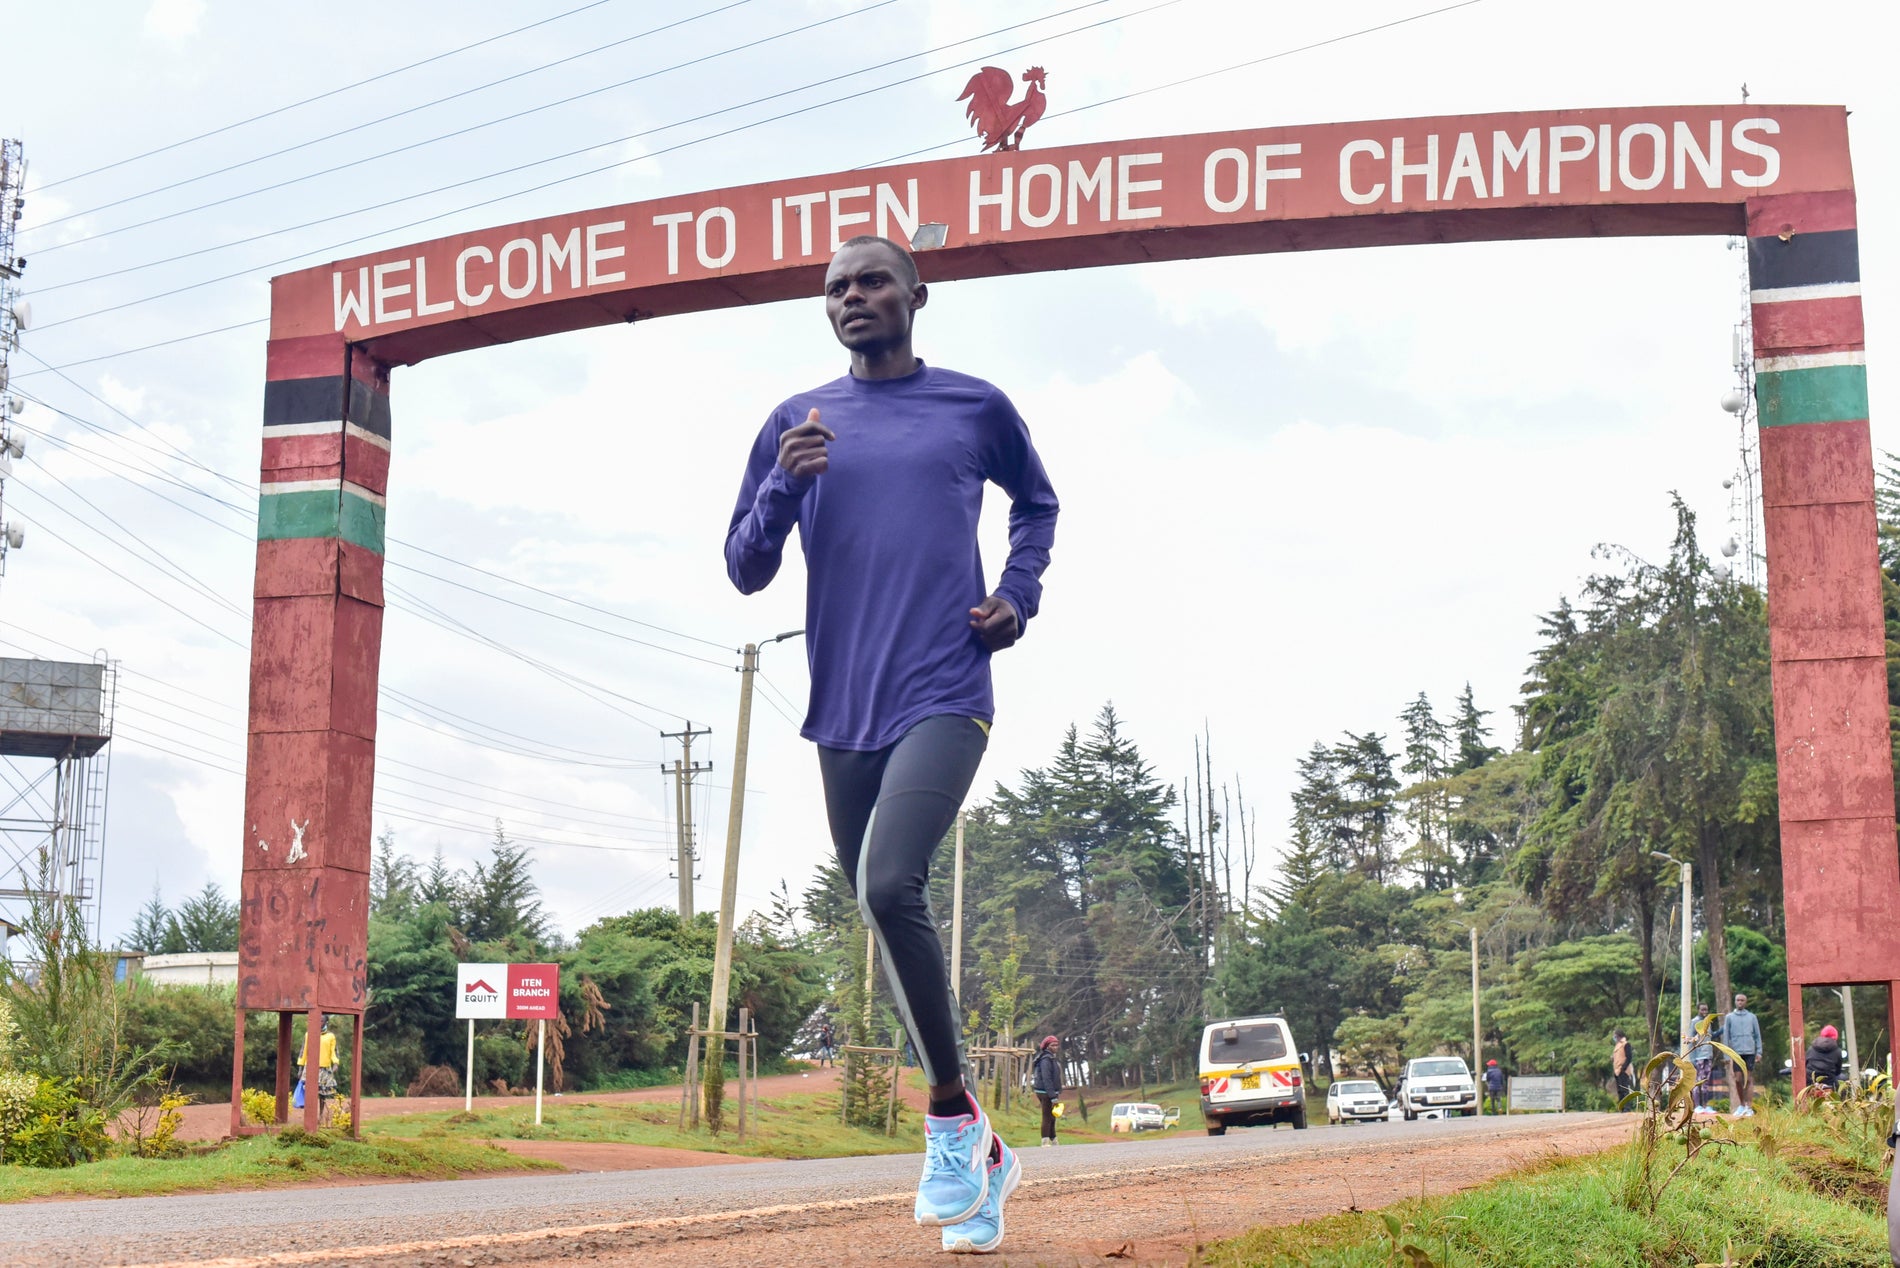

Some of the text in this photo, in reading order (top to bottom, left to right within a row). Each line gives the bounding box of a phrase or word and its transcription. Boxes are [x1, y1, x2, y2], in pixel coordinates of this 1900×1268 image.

[333, 118, 1781, 332] WELCOME TO ITEN HOME OF CHAMPIONS
[521, 978, 542, 987] ITEN
[513, 988, 550, 997] BRANCH
[465, 995, 498, 1003] EQUITY
